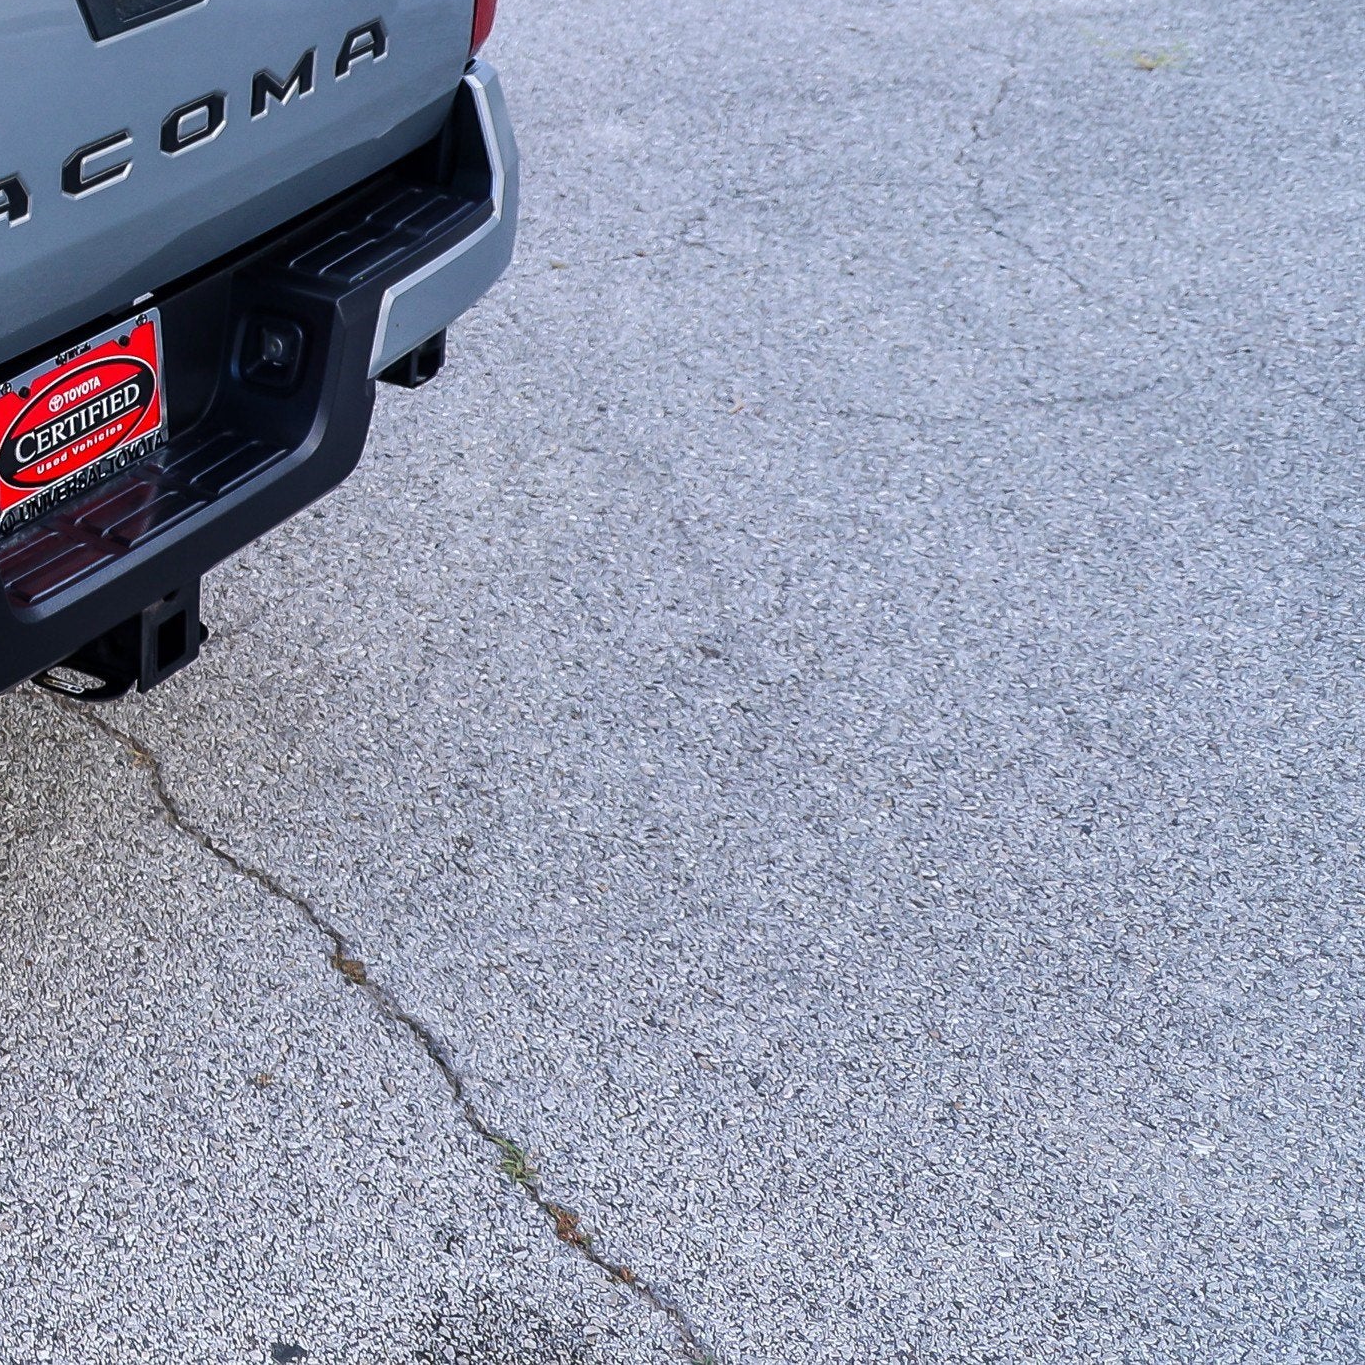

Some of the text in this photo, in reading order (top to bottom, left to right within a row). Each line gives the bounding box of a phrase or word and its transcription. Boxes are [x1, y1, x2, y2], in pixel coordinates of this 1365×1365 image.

[15, 383, 140, 464] CERTIFIED
[63, 376, 101, 405] TOYOTA
[19, 430, 163, 521] UNIVERSAL TOYOTA
[36, 423, 123, 475] Used Vehicles
